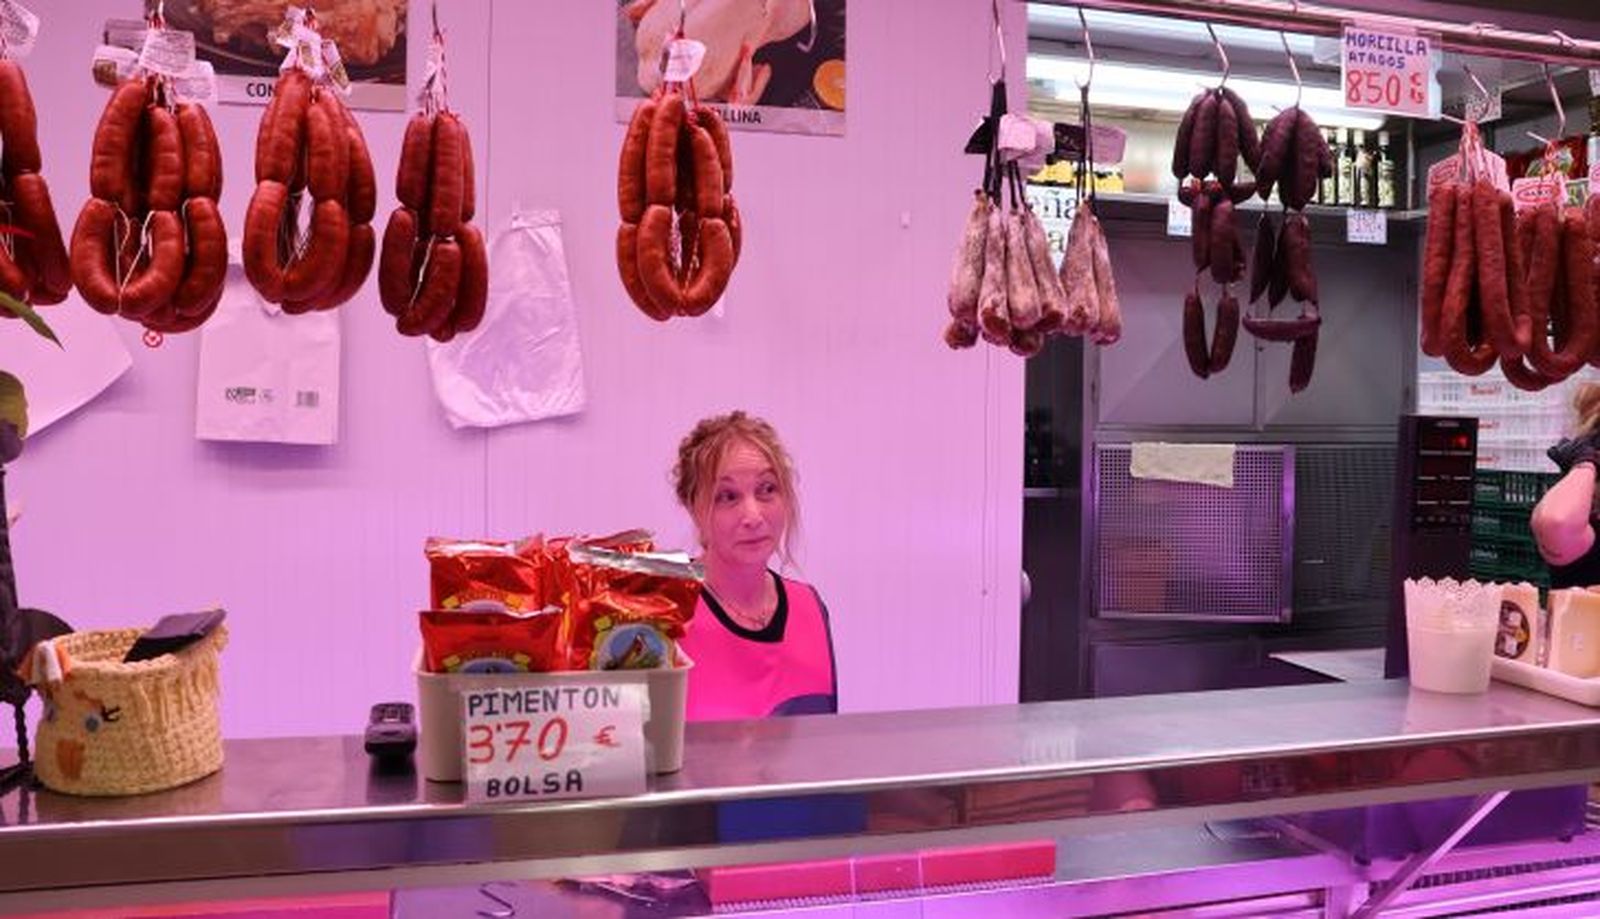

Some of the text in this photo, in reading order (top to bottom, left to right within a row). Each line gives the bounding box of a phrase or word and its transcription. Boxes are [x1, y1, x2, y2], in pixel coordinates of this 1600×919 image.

[1346, 32, 1427, 56] MORCILLA
[246, 82, 274, 97] CON
[722, 107, 762, 124] LLINA
[468, 685, 621, 718] PIMENTON
[485, 768, 584, 799] BOLSA
